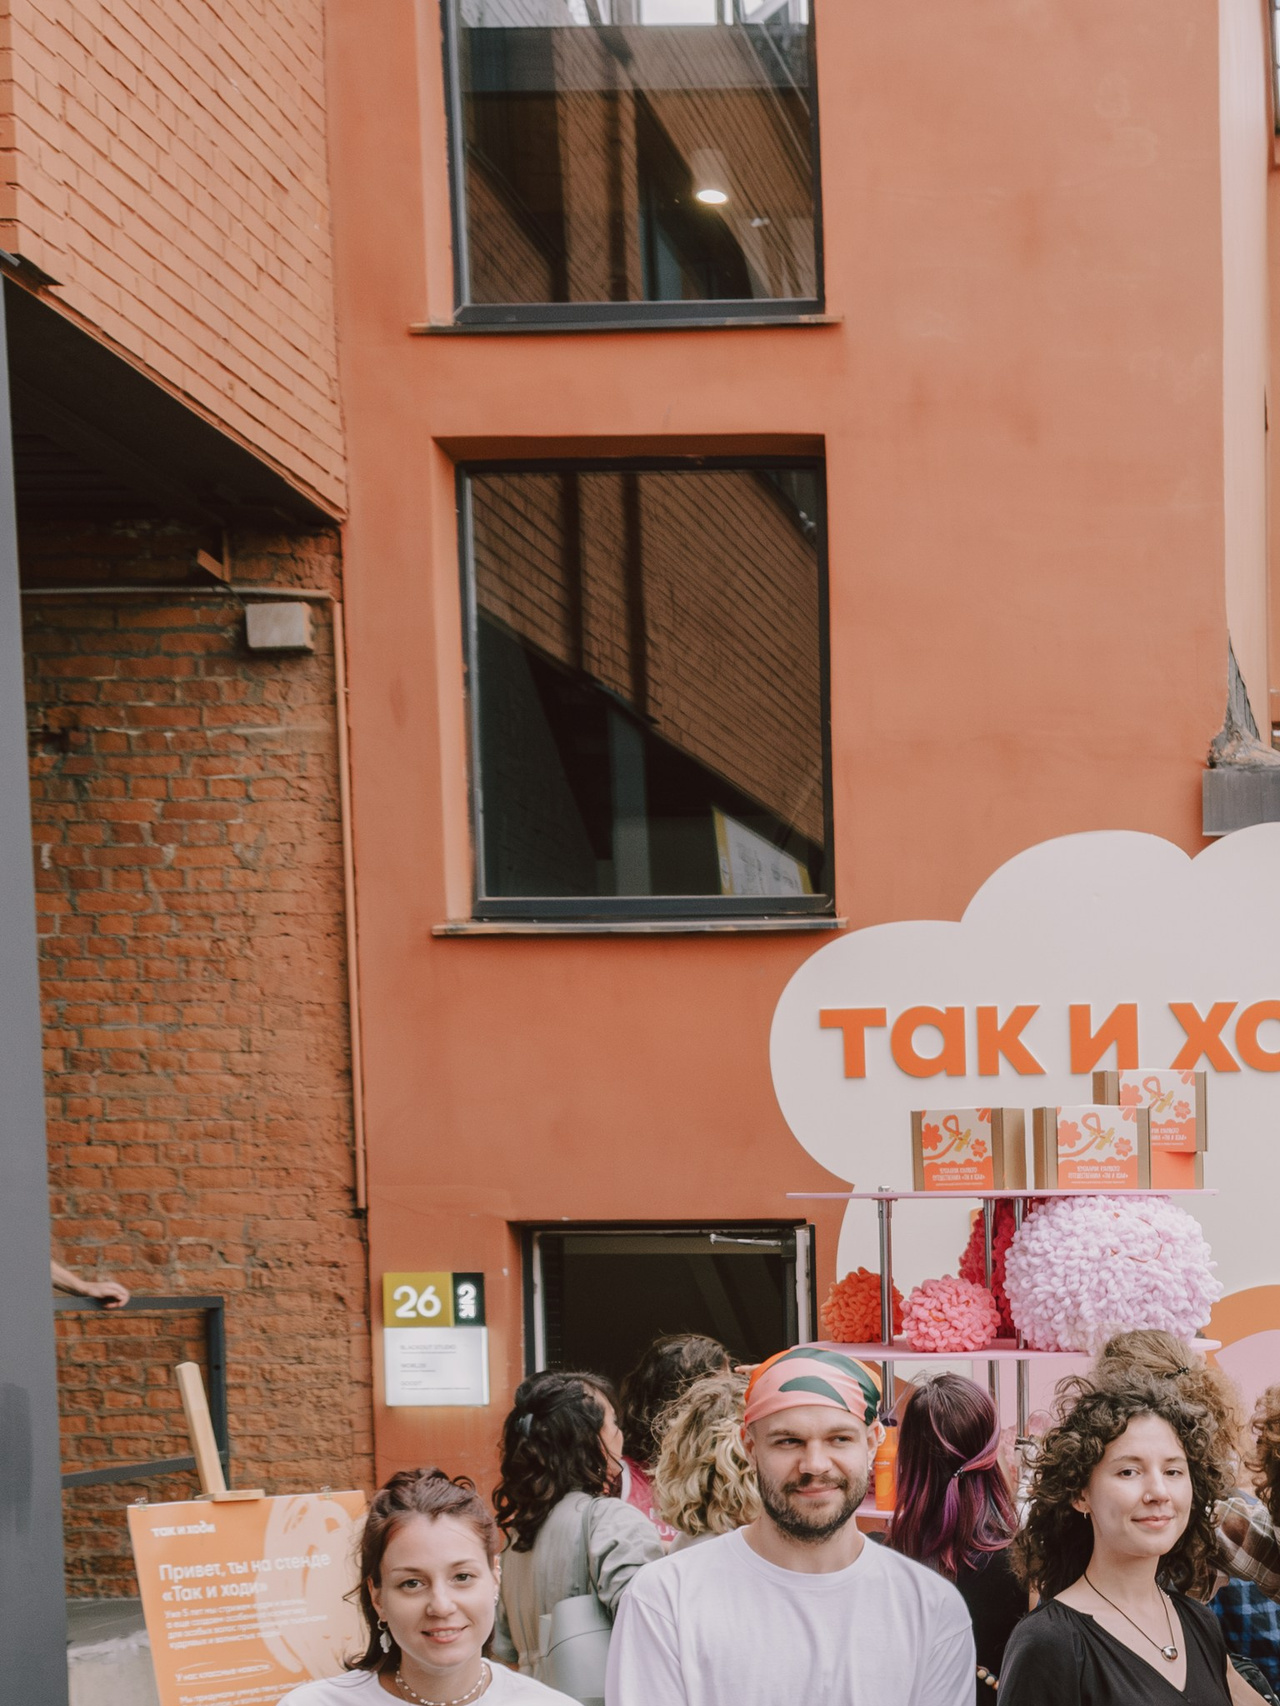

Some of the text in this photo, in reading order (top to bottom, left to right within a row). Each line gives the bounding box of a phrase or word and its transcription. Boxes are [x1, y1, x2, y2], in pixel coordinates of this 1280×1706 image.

[820, 1005, 1046, 1078] так
[1069, 1003, 1139, 1075] и
[393, 1284, 442, 1318] 26
[159, 1554, 331, 1582] Привет, ты на стенде
[161, 1582, 268, 1602] «Так и ходи»
